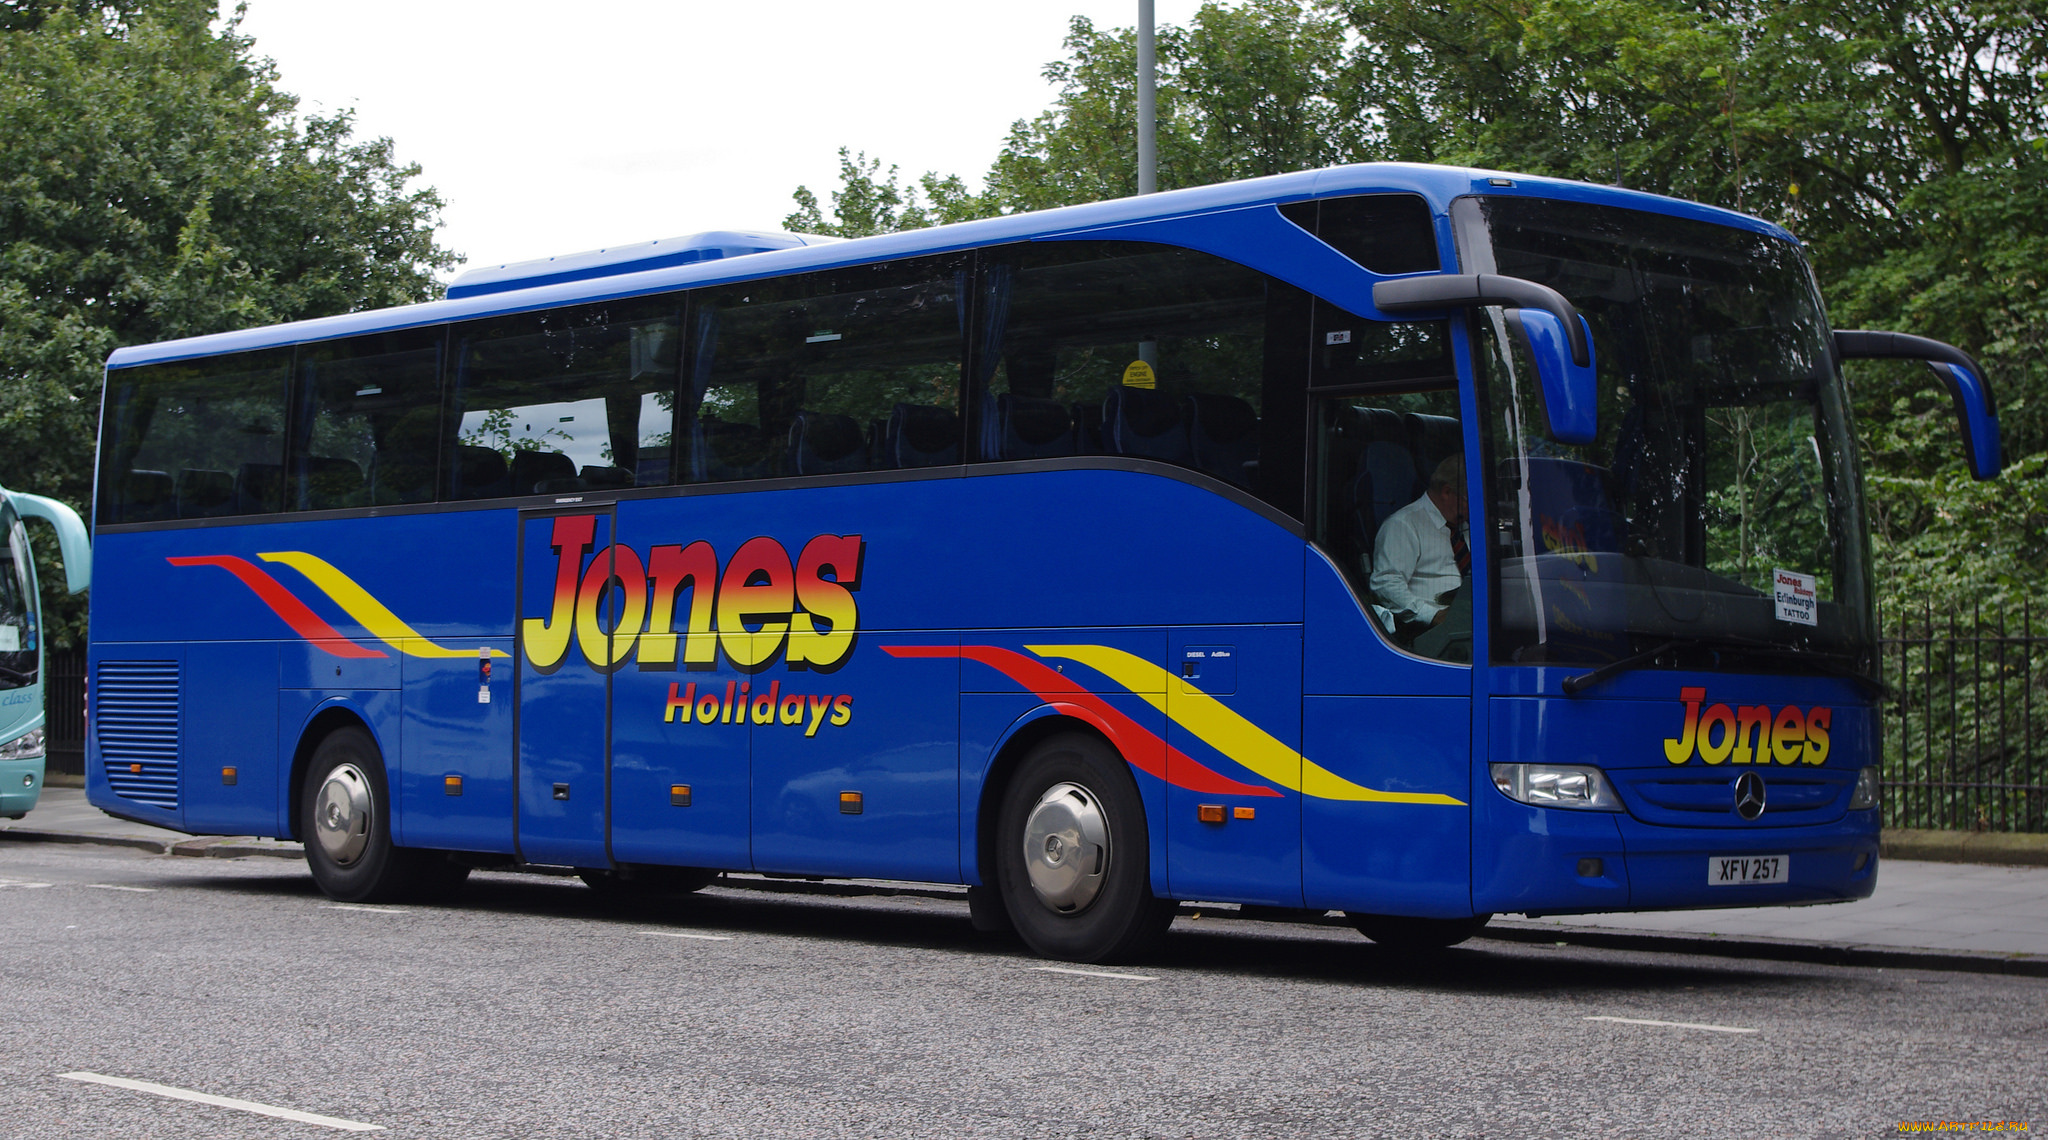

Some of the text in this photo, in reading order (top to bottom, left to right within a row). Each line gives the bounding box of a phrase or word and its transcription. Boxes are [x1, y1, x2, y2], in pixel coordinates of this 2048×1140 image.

[1776, 573, 1802, 588] Jones
[522, 514, 865, 672] Jones
[1783, 608, 1810, 620] TATTOO
[2, 690, 33, 706] class
[664, 680, 854, 738] Holidays
[1663, 686, 1832, 766] Jones
[1720, 858, 1779, 881] XFV 257
